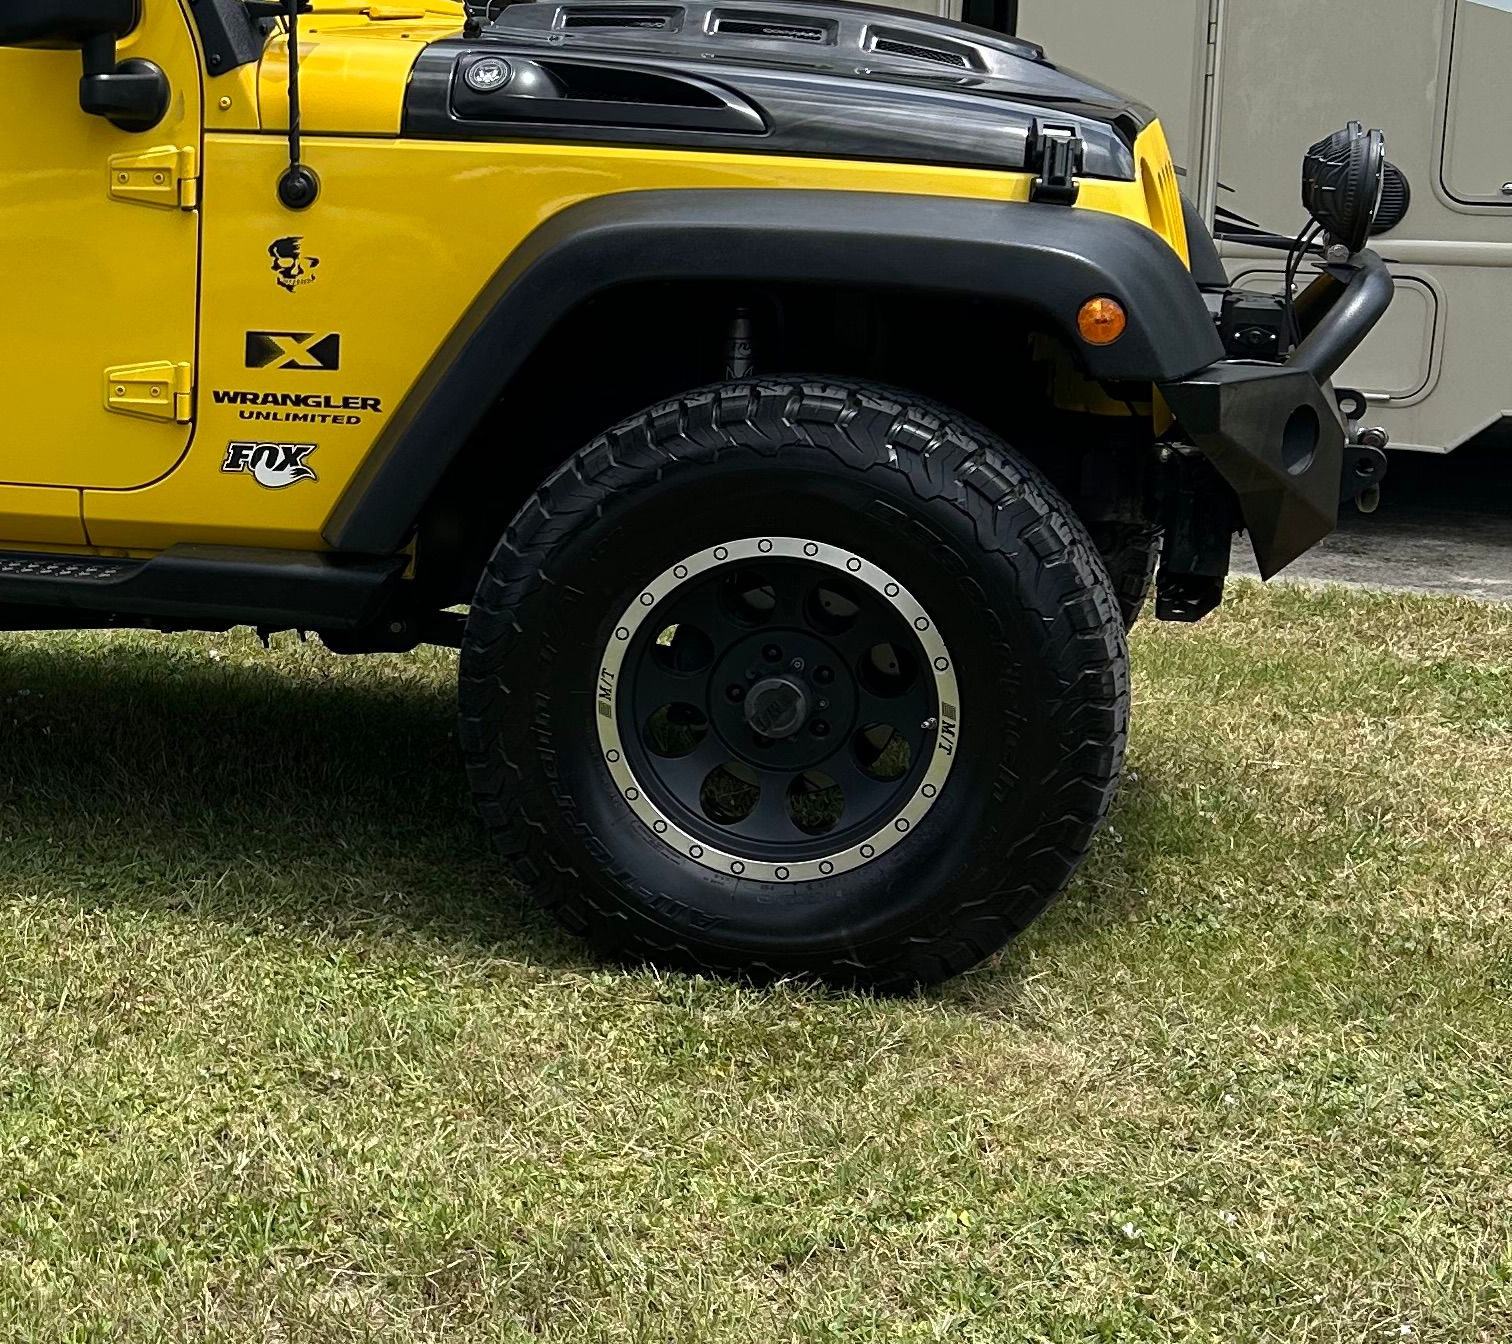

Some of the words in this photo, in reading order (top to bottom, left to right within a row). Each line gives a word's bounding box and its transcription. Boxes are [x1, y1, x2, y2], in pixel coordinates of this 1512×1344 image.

[212, 390, 383, 413] WRANGLER
[238, 409, 362, 425] UNLIMITED
[221, 441, 318, 474] FOX
[598, 667, 615, 702] M/T
[938, 719, 956, 756] M/T
